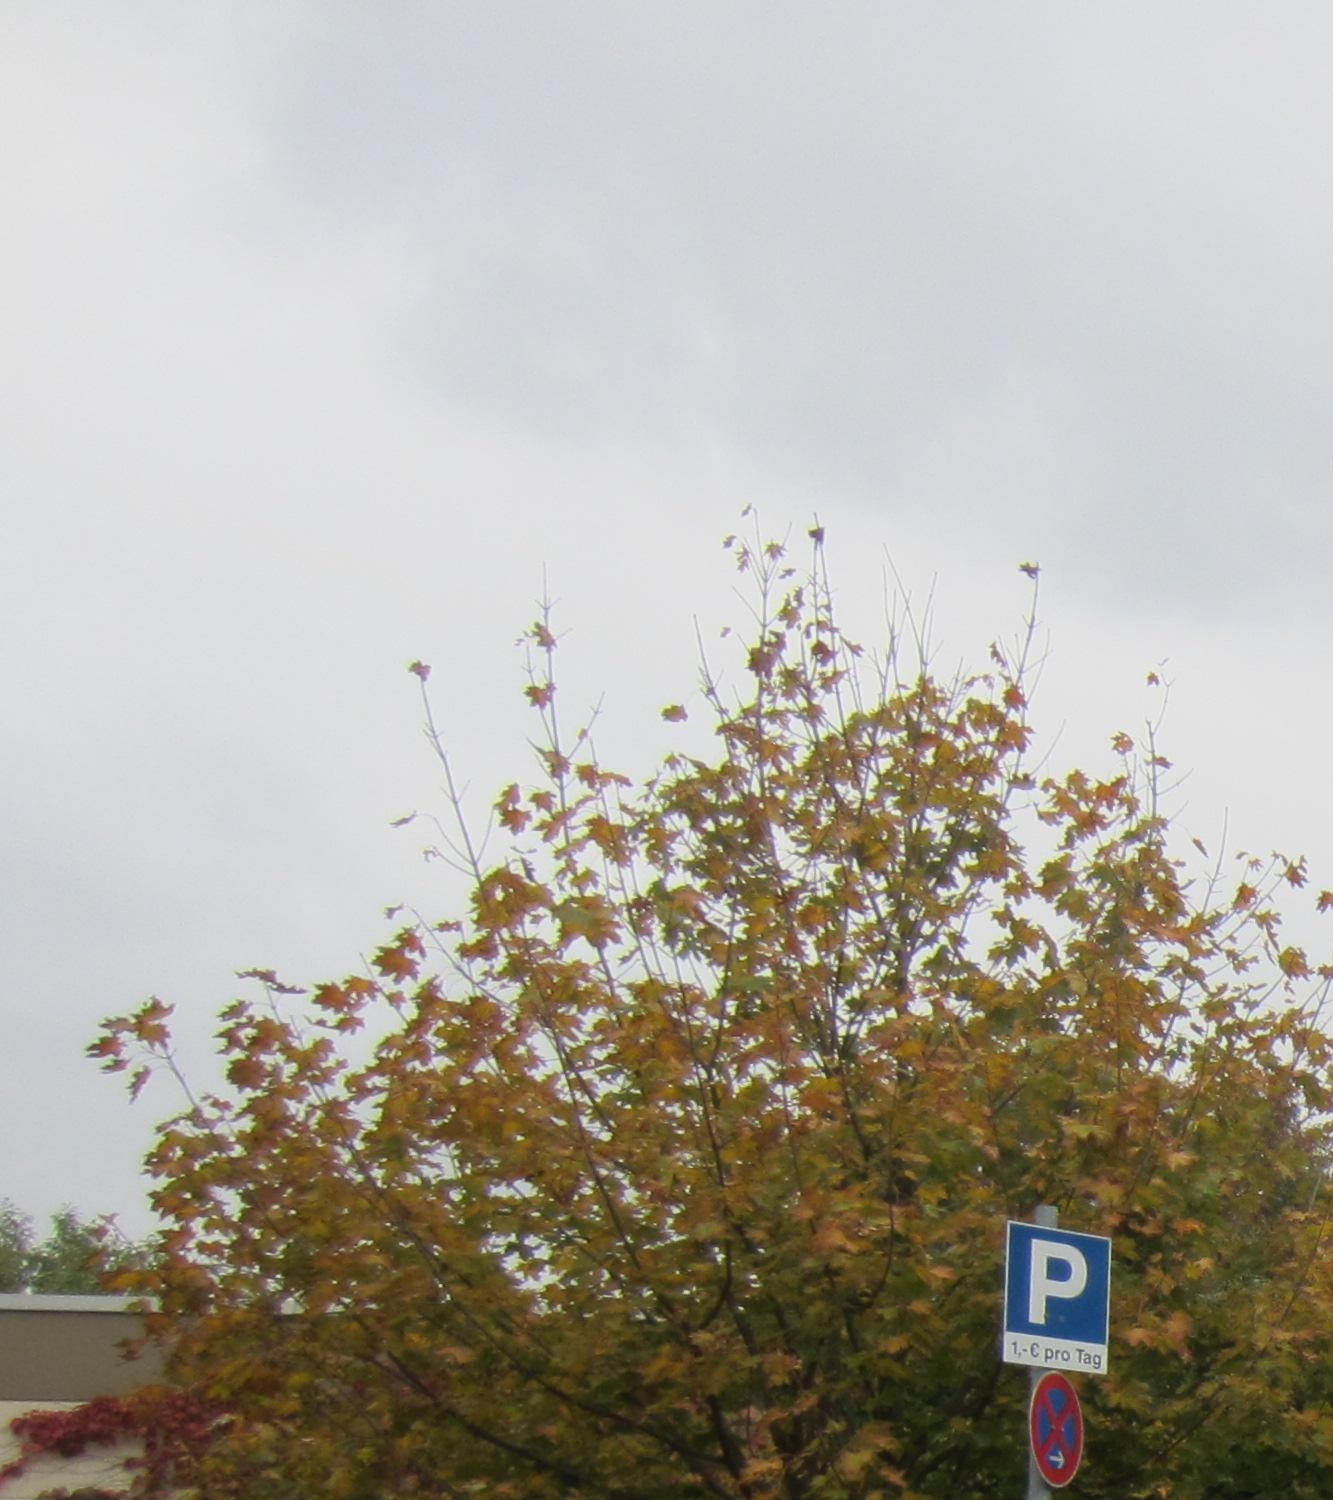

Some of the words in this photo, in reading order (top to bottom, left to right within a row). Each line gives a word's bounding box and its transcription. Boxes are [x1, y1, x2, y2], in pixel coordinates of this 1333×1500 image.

[1028, 1238, 1088, 1325] P
[1044, 1347, 1071, 1363] pro
[1075, 1348, 1102, 1370] Tag
